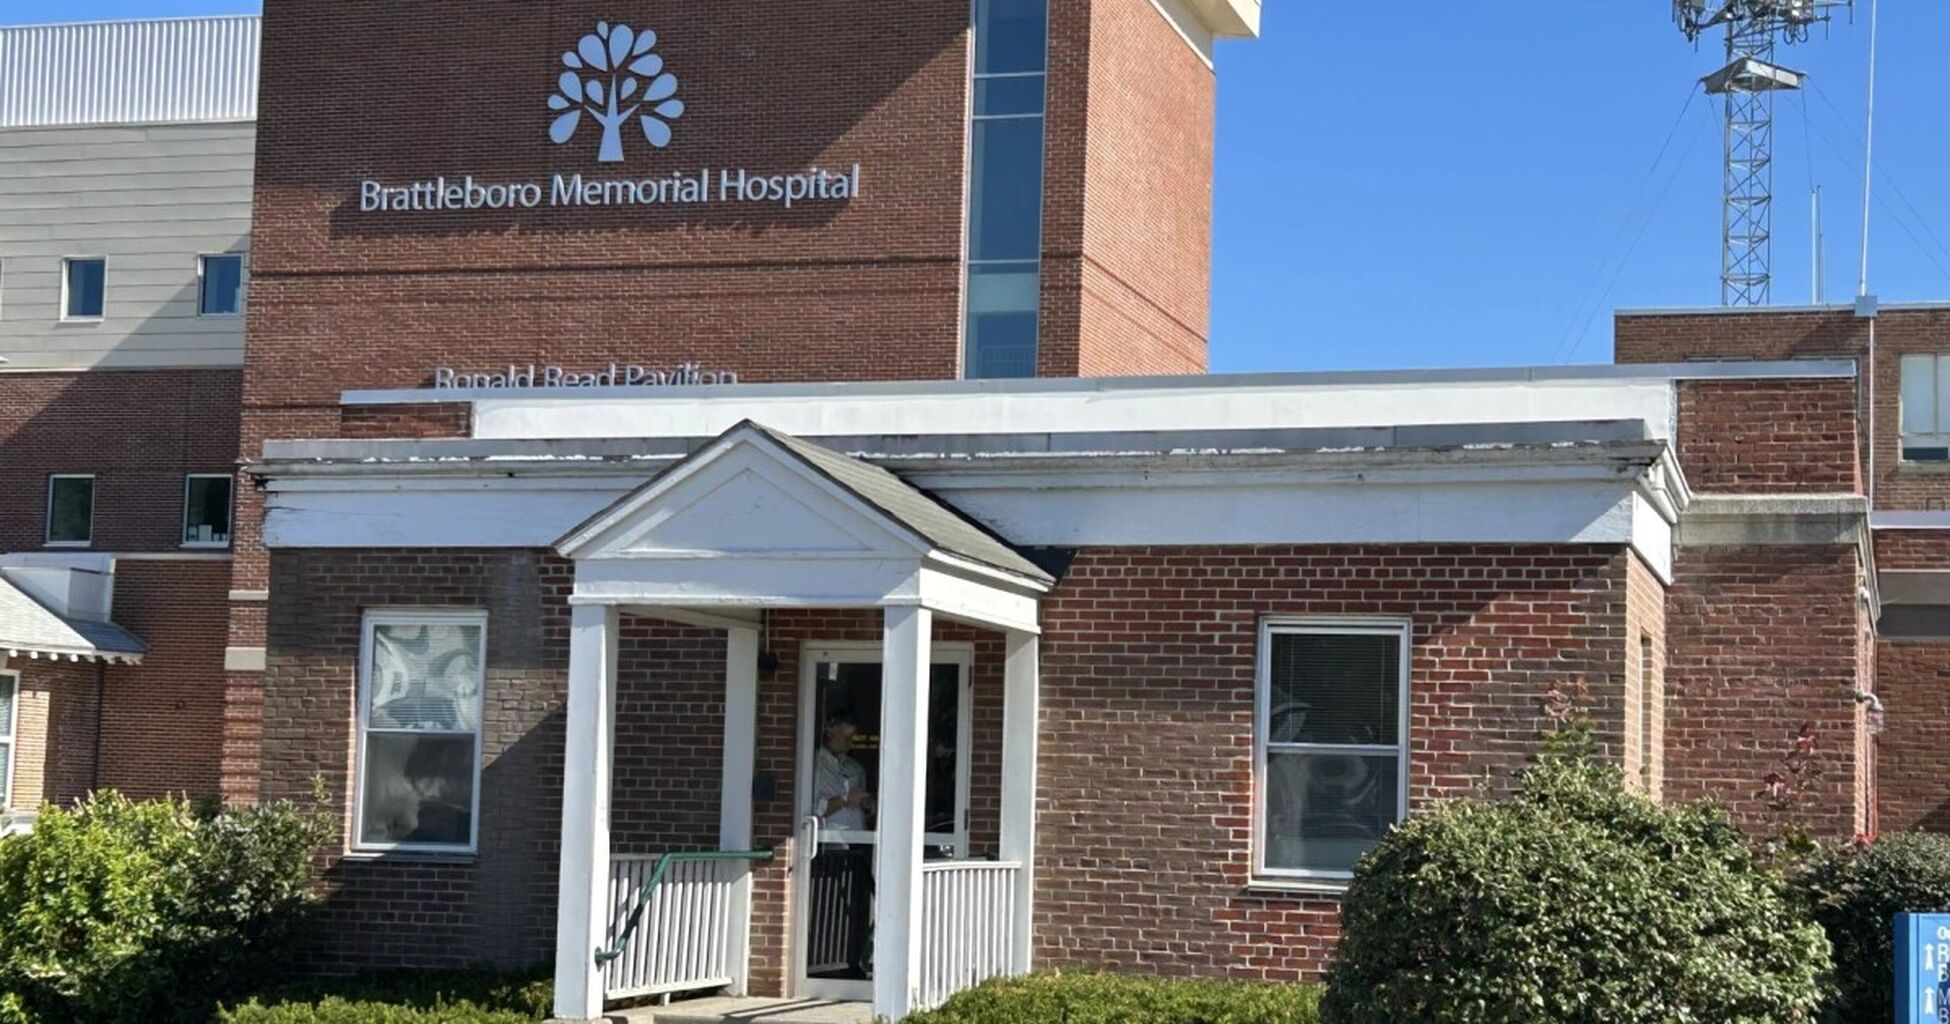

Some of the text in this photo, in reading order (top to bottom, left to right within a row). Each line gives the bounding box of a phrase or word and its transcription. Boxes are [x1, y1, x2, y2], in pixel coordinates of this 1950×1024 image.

[360, 163, 860, 212] Brattleboro Memorial Hospital
[434, 361, 738, 389] Ronald Read Pavilion
